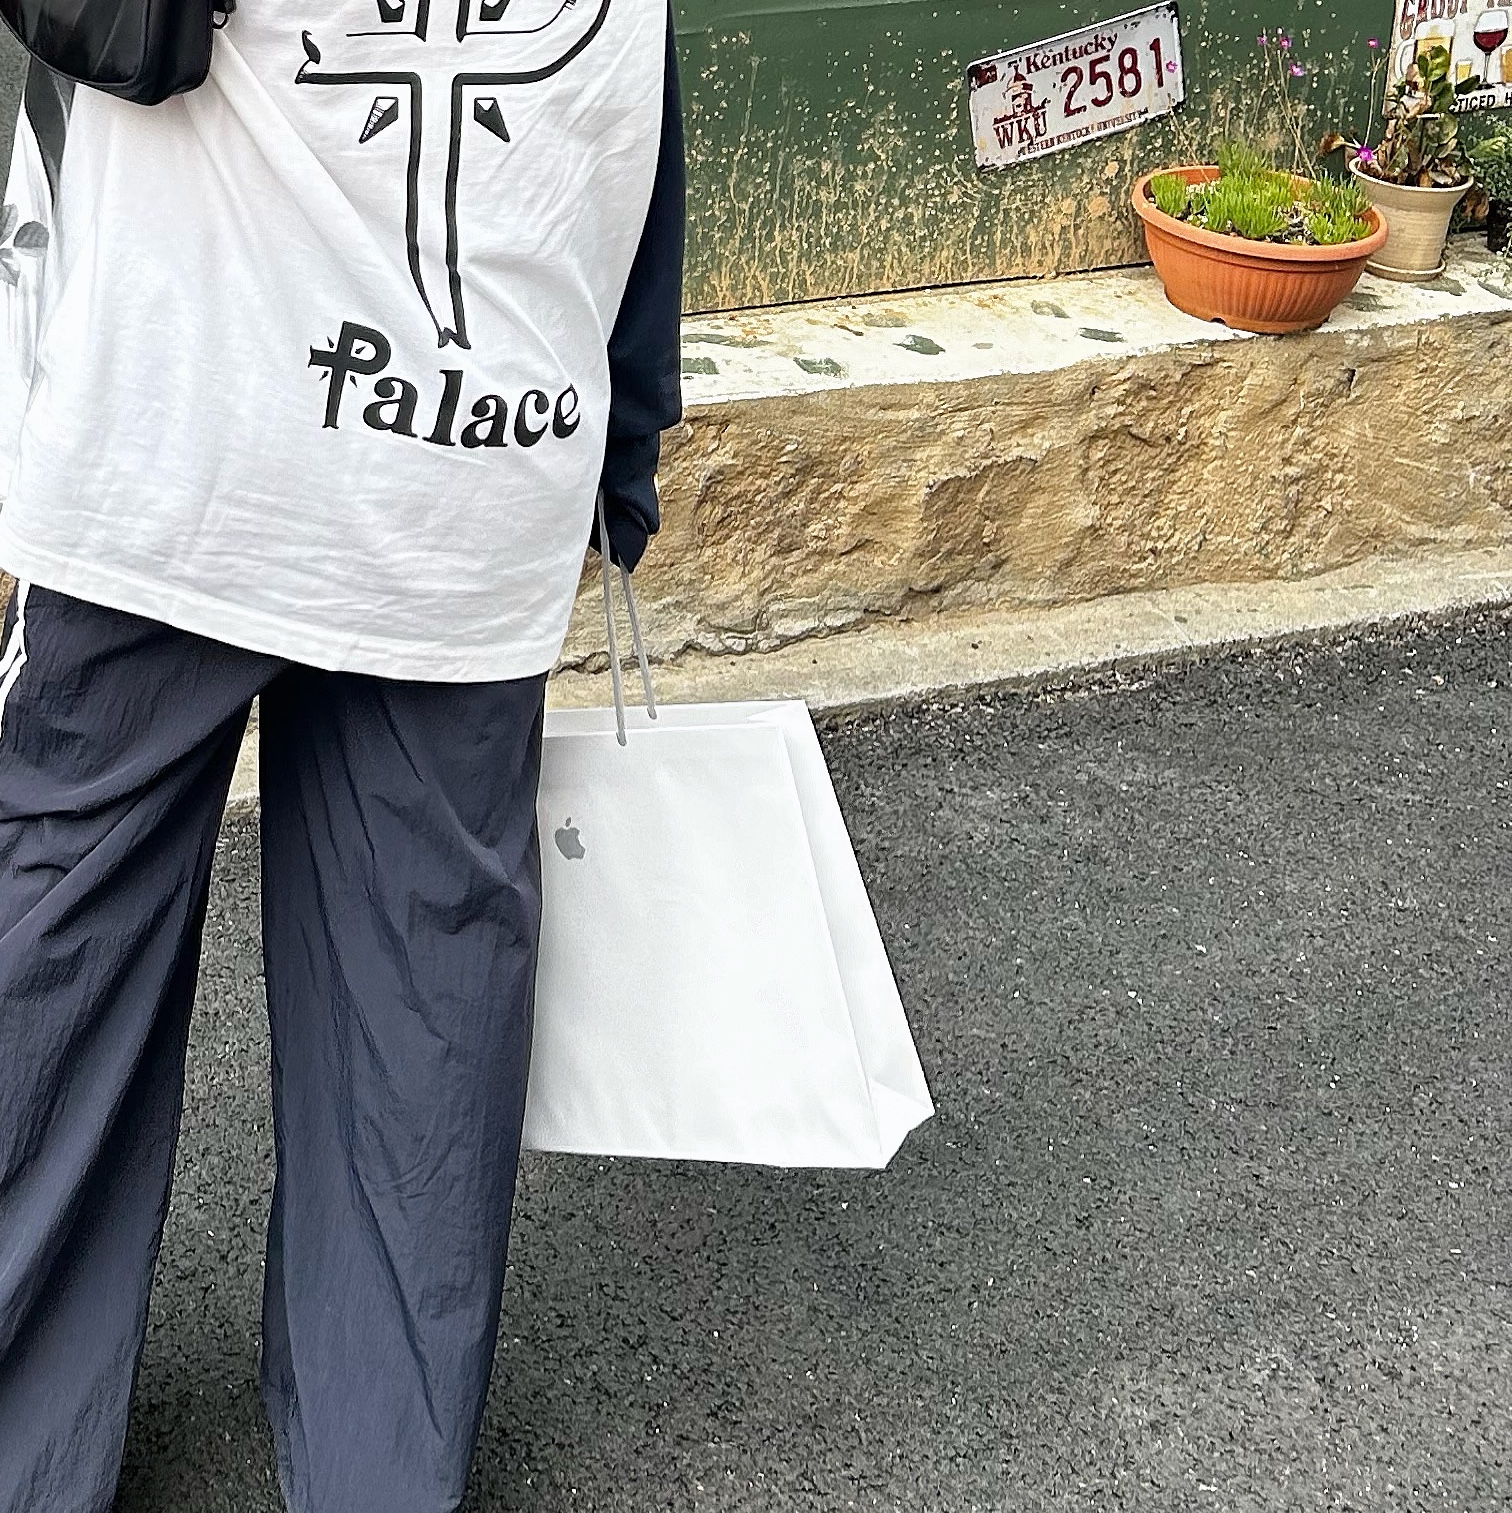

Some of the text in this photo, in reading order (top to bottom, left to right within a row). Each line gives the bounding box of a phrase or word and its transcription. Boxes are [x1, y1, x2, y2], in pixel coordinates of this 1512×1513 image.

[1025, 32, 1119, 75] Kentucky
[1059, 37, 1165, 119] 2581
[992, 110, 1049, 150] WKU
[307, 320, 582, 450] Palace
